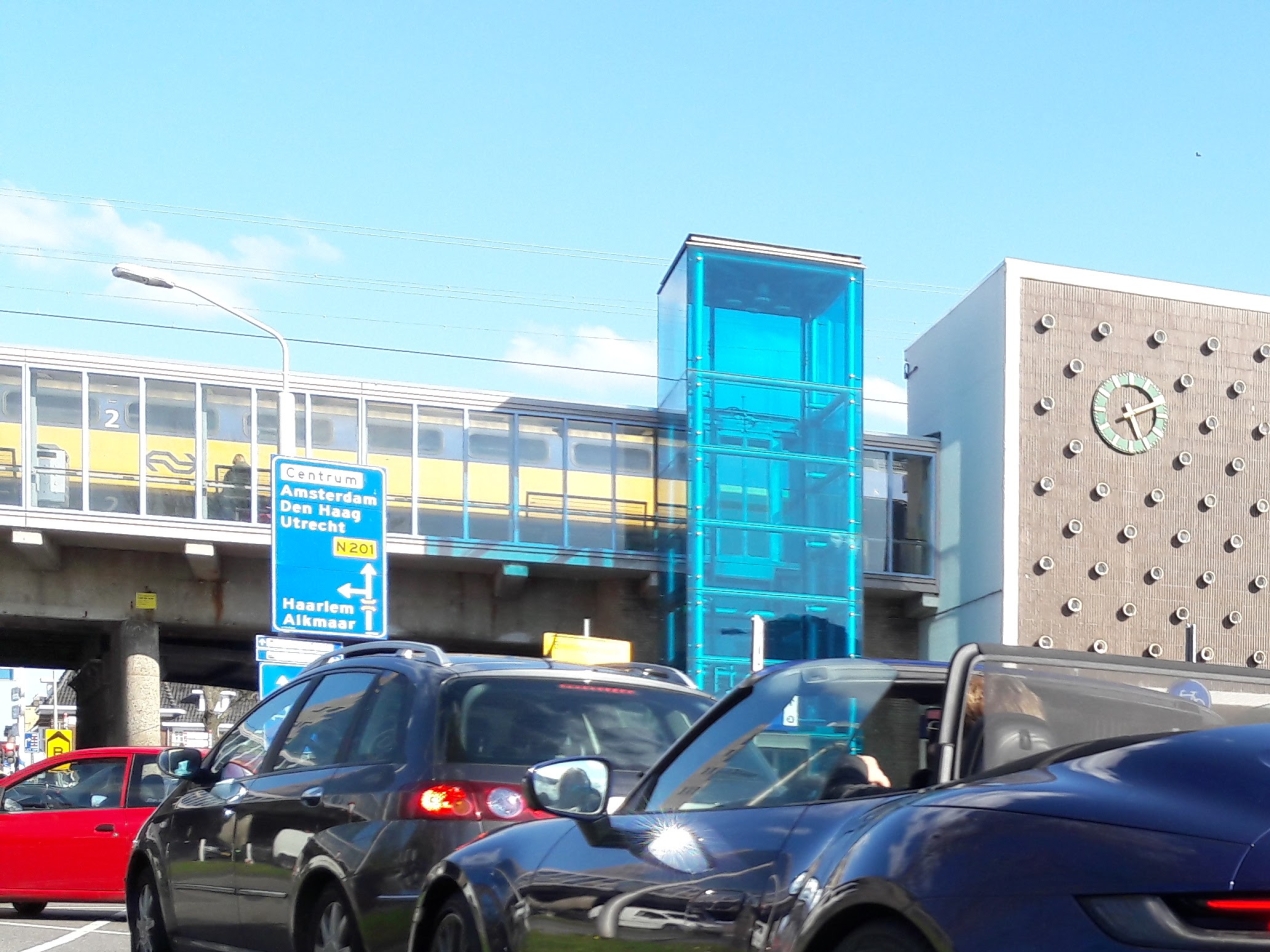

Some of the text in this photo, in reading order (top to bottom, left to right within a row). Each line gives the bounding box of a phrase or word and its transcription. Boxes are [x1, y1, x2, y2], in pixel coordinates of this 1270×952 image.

[104, 409, 120, 429] 2
[286, 467, 357, 486] Centrum
[280, 484, 377, 506] Amsterdam
[280, 500, 361, 523] Den Haag
[280, 515, 346, 534] Utrecht
[282, 597, 354, 615] Haarlem
[282, 613, 356, 631] Alkmaar
